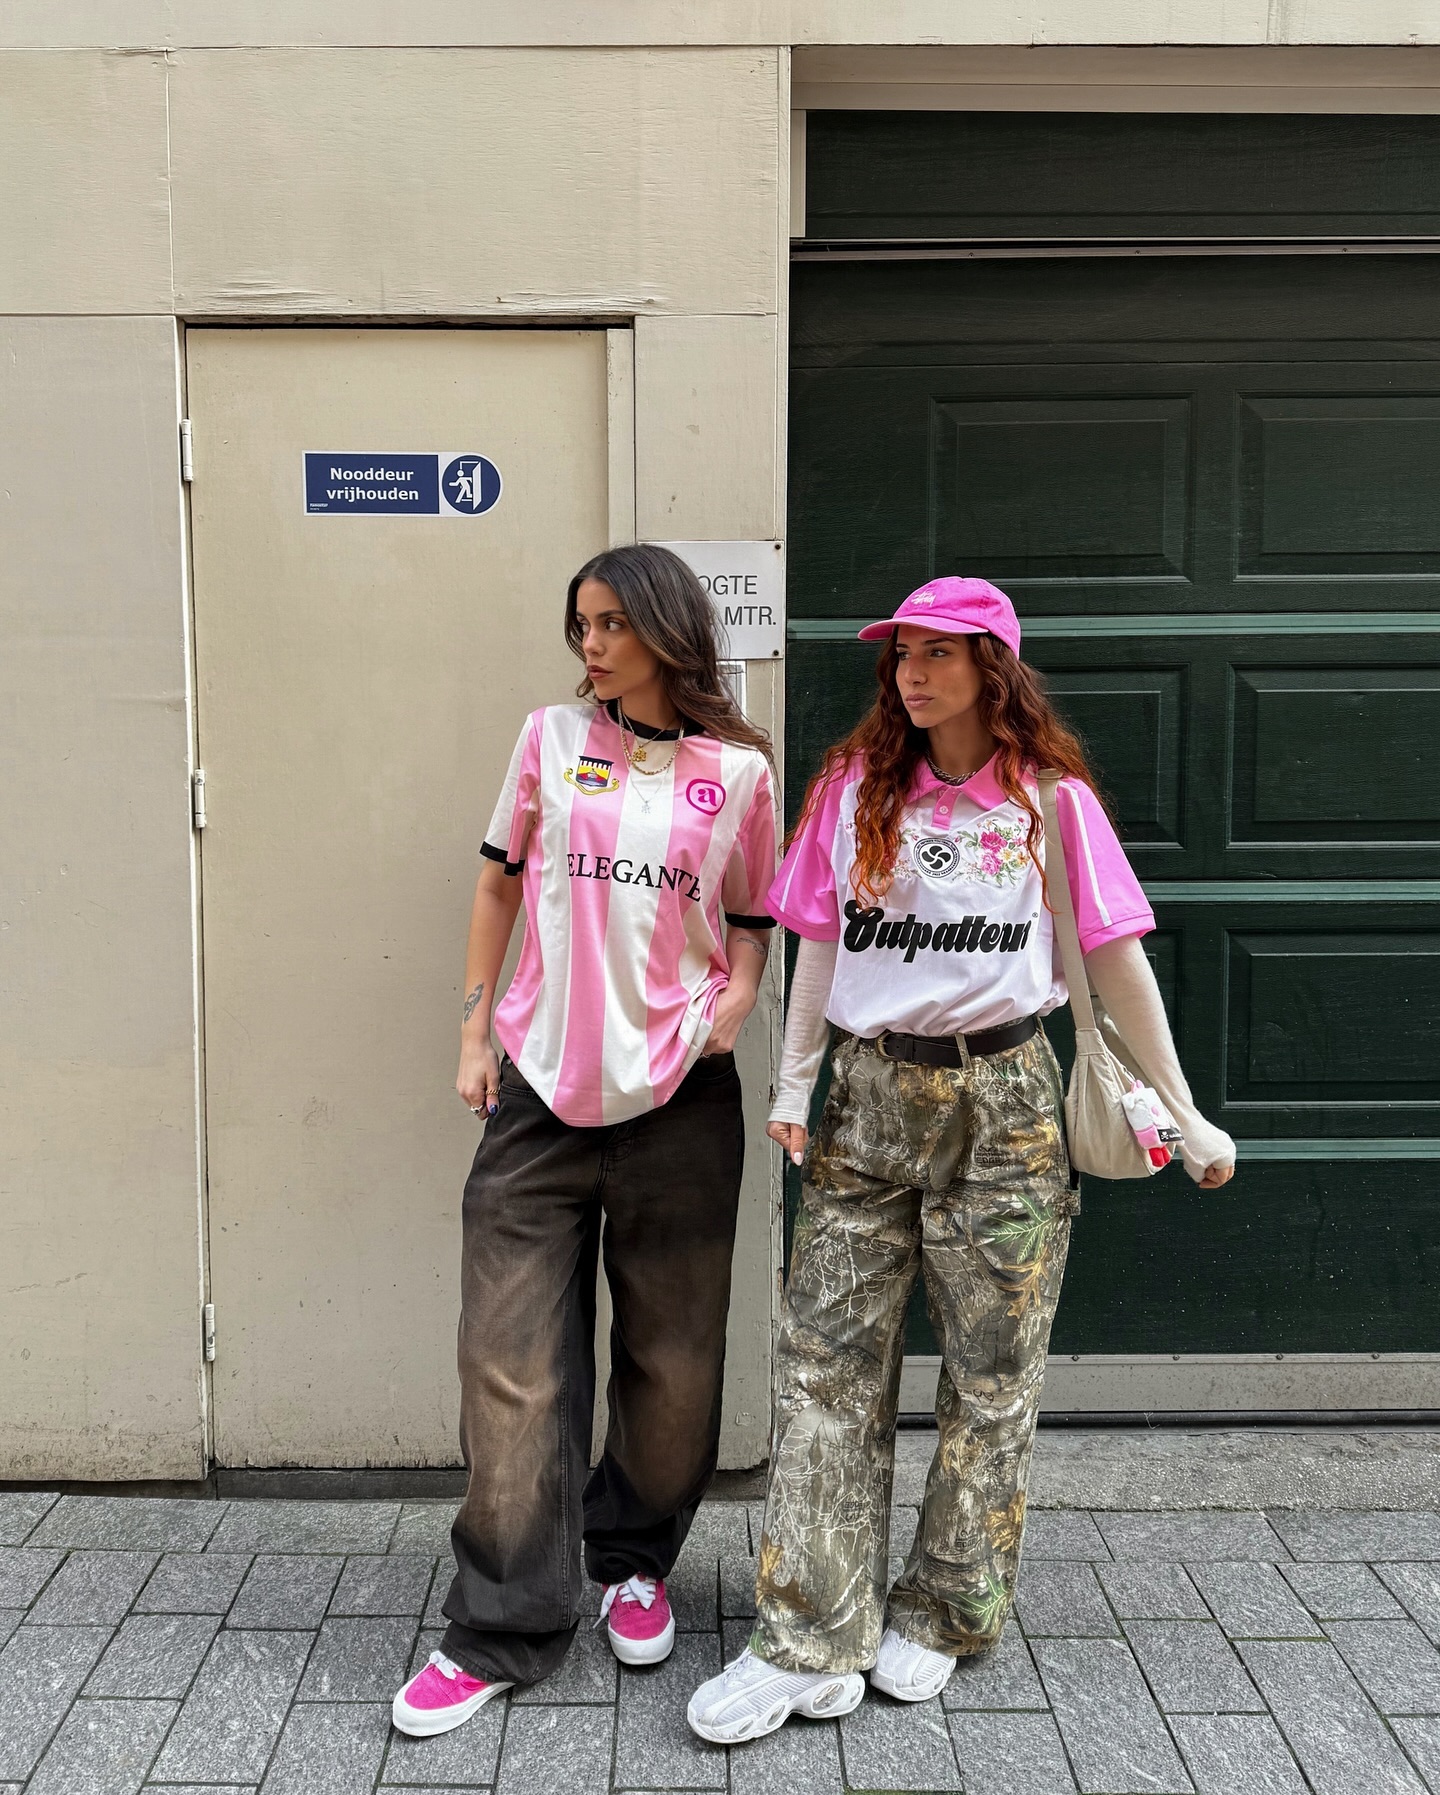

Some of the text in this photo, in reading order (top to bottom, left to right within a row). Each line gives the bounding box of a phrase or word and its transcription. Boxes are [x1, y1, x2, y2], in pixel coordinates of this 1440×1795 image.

[330, 467, 414, 481] Nooddeur
[326, 487, 419, 502] vrijhouden
[724, 606, 777, 626] MTR.
[566, 853, 701, 902] ELEGANTE
